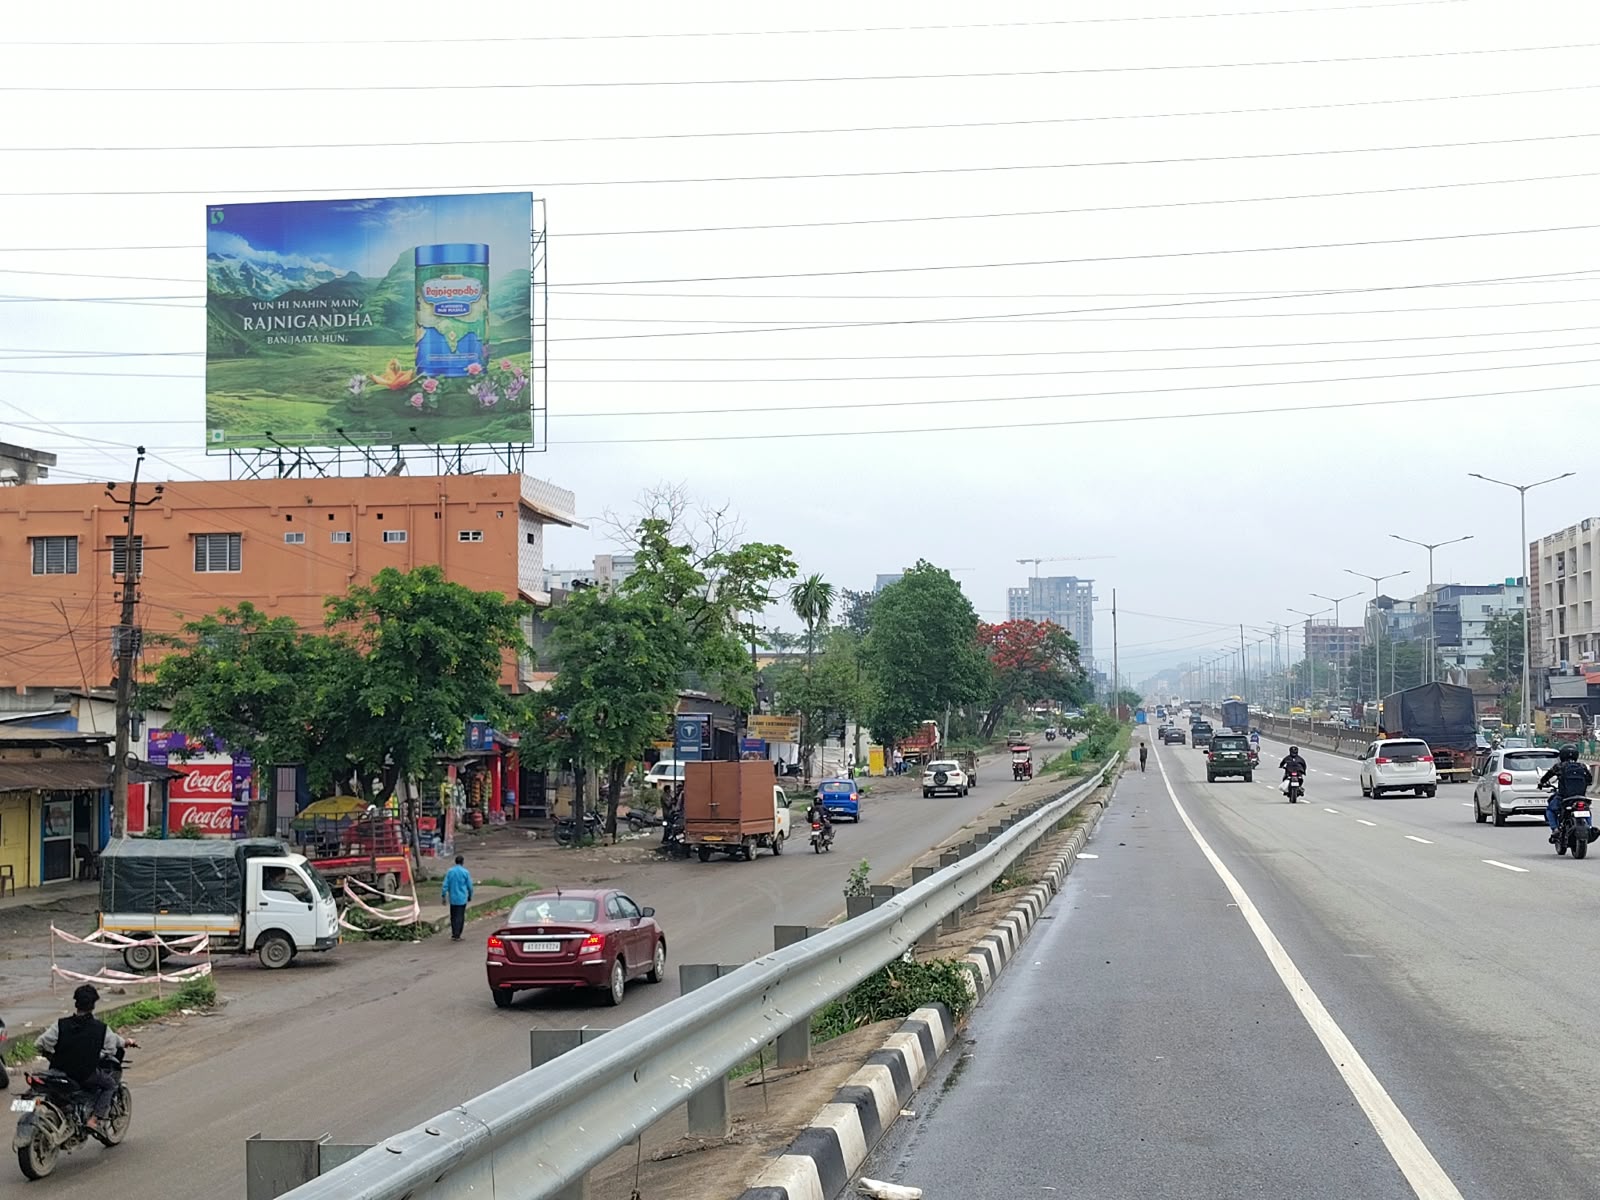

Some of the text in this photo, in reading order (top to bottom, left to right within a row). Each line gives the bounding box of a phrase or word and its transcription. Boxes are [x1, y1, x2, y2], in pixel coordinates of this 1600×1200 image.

[251, 299, 363, 311] YUN HI NAHIN MAIN,
[243, 312, 374, 332] RAJNIGANDHA
[266, 336, 288, 345] BAN
[288, 335, 320, 345] JAATA
